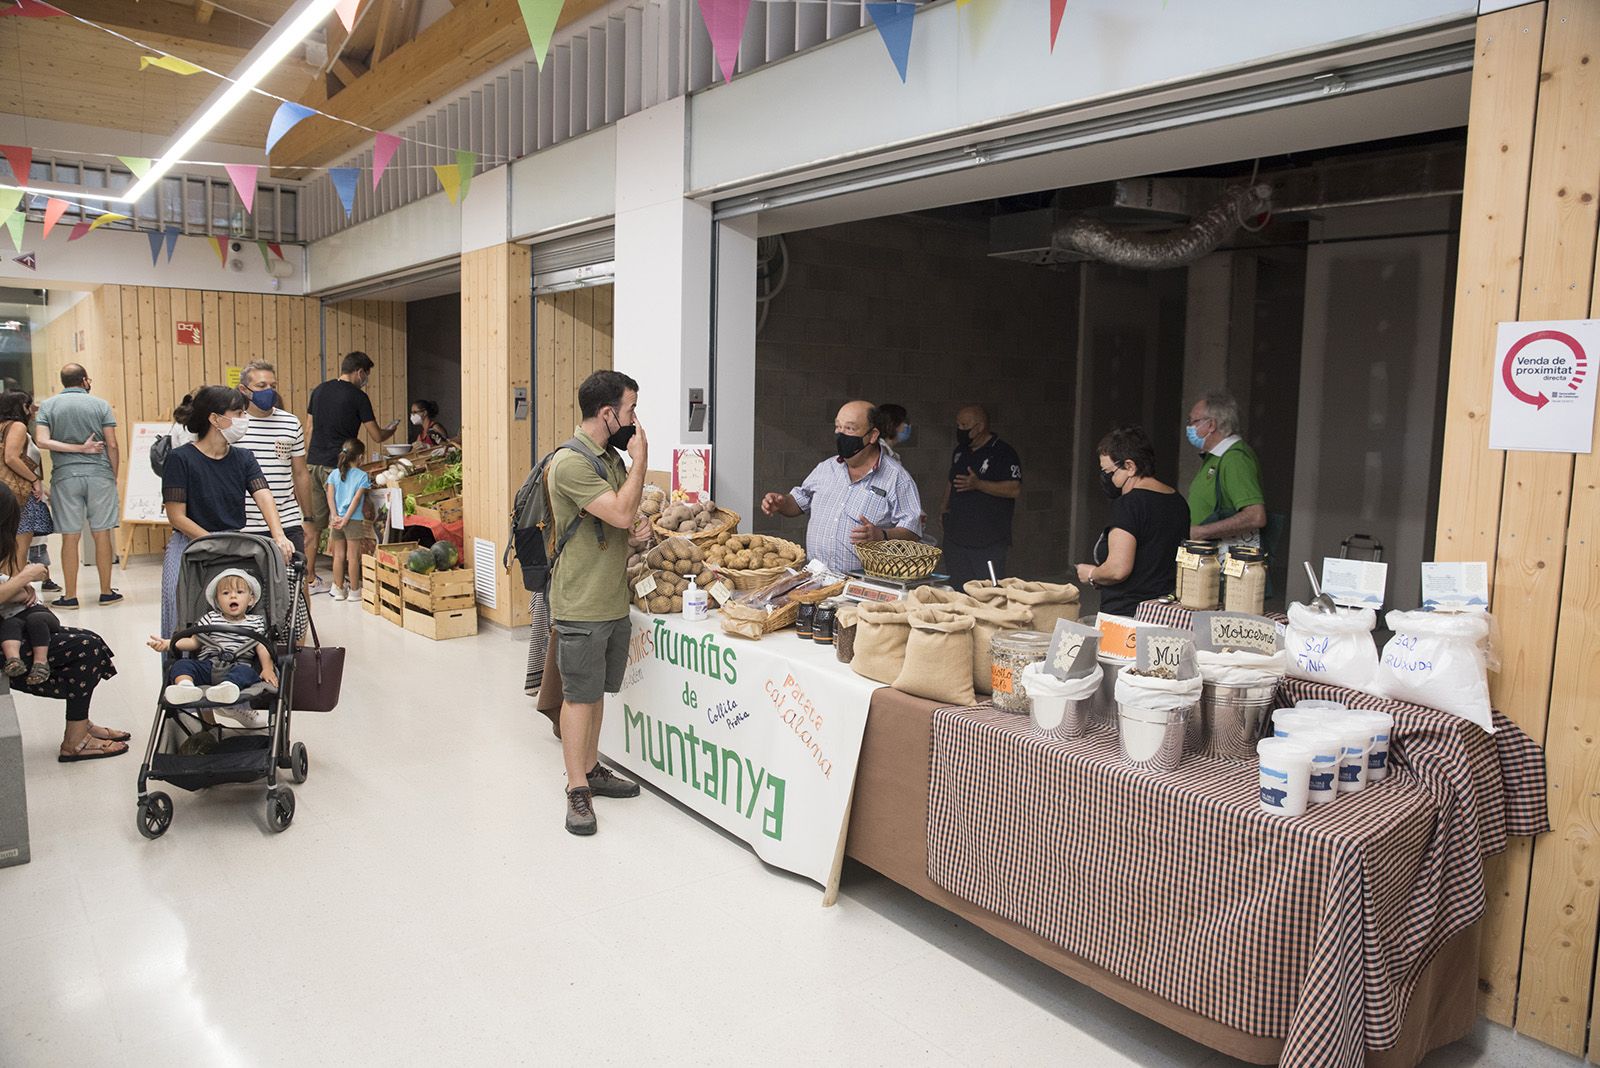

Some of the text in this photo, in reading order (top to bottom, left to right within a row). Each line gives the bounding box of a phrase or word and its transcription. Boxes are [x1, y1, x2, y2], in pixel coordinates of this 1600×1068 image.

[1515, 365, 1573, 376] proximitat
[1517, 356, 1566, 366] Venda de
[653, 618, 737, 685] Trumfos
[1305, 636, 1329, 655] Sal
[682, 681, 698, 709] de
[623, 703, 786, 842] Muntanya
